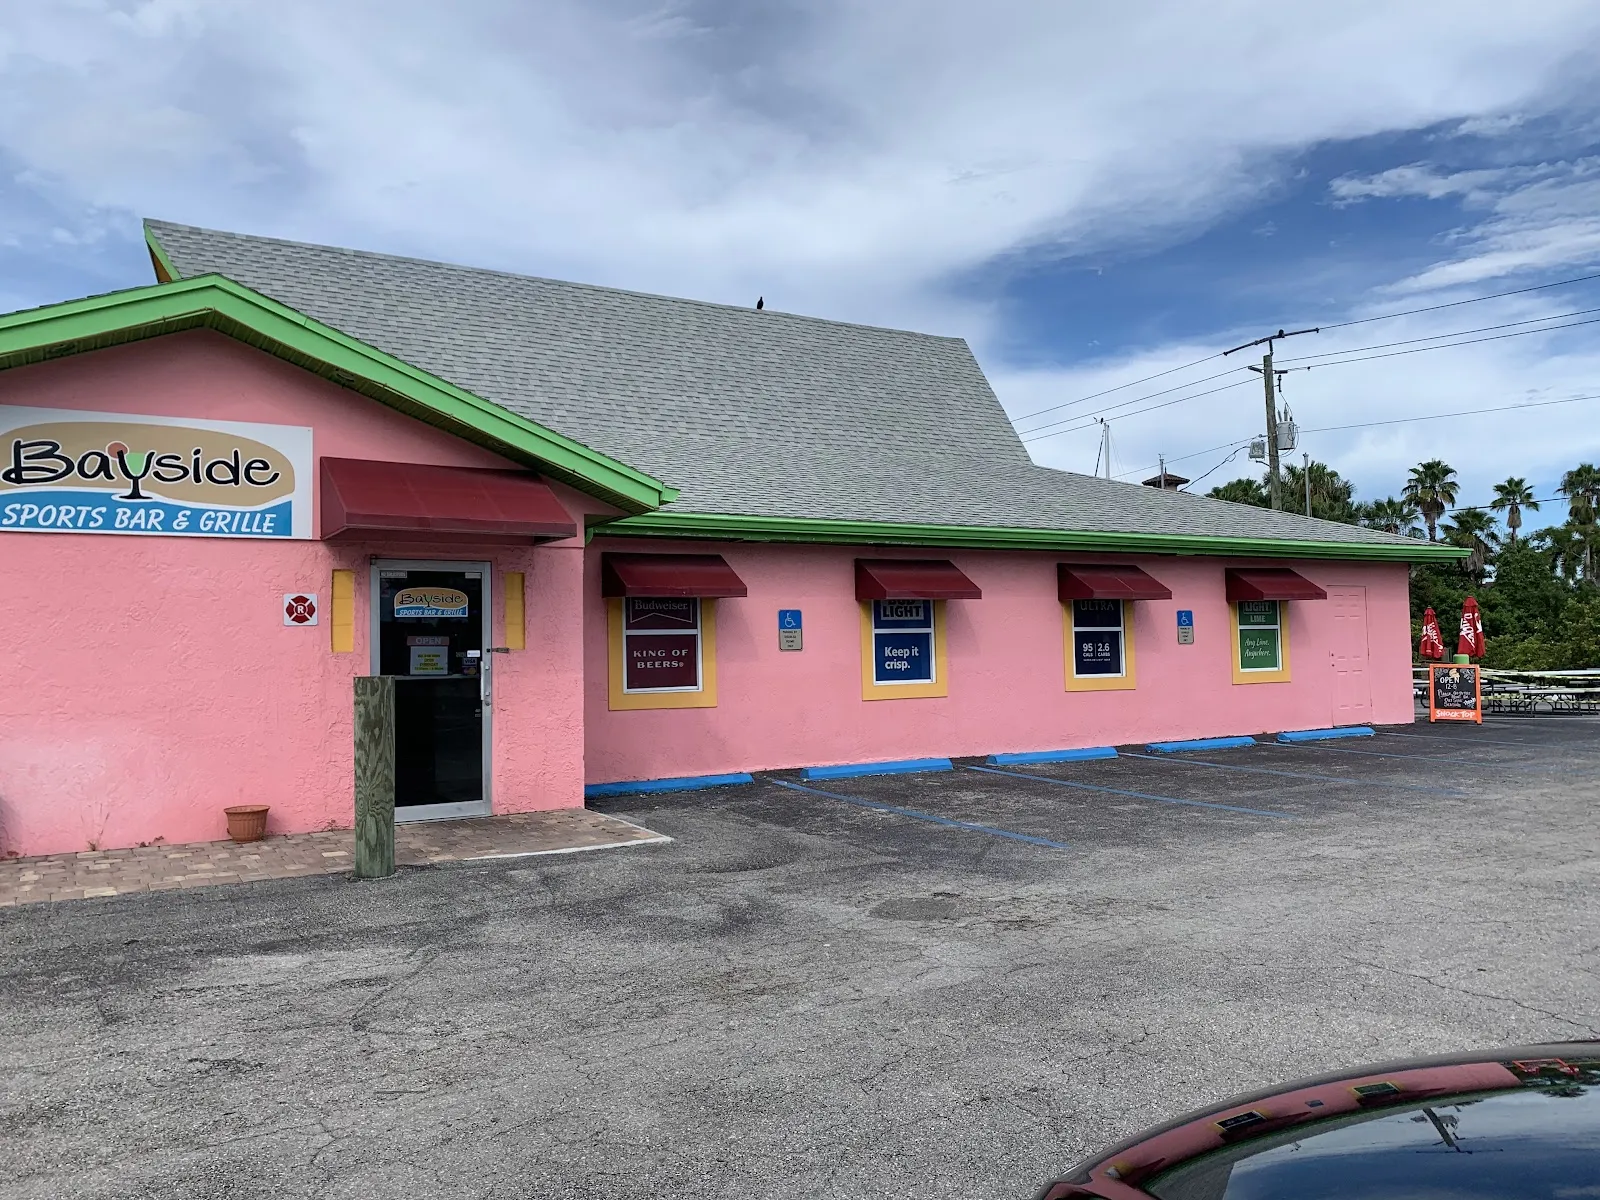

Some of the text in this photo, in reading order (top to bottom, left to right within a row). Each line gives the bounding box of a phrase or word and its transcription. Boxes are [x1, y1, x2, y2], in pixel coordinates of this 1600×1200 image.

[1, 439, 280, 499] Bayside
[2, 503, 277, 533] SPORTS BAR & GRILLE
[399, 593, 464, 607] Bayside
[634, 600, 688, 610] Budweiser
[1080, 600, 1114, 610] ULTRA
[297, 605, 304, 613] R
[882, 606, 921, 617] LIGHT
[1244, 602, 1270, 611] LIGHT
[884, 646, 919, 658] Keep it
[1082, 643, 1093, 651] 95
[1098, 643, 1110, 651] 2.6
[884, 659, 910, 671] crisp.
[1440, 676, 1460, 684] OPEN
[1461, 710, 1476, 718] TOP
